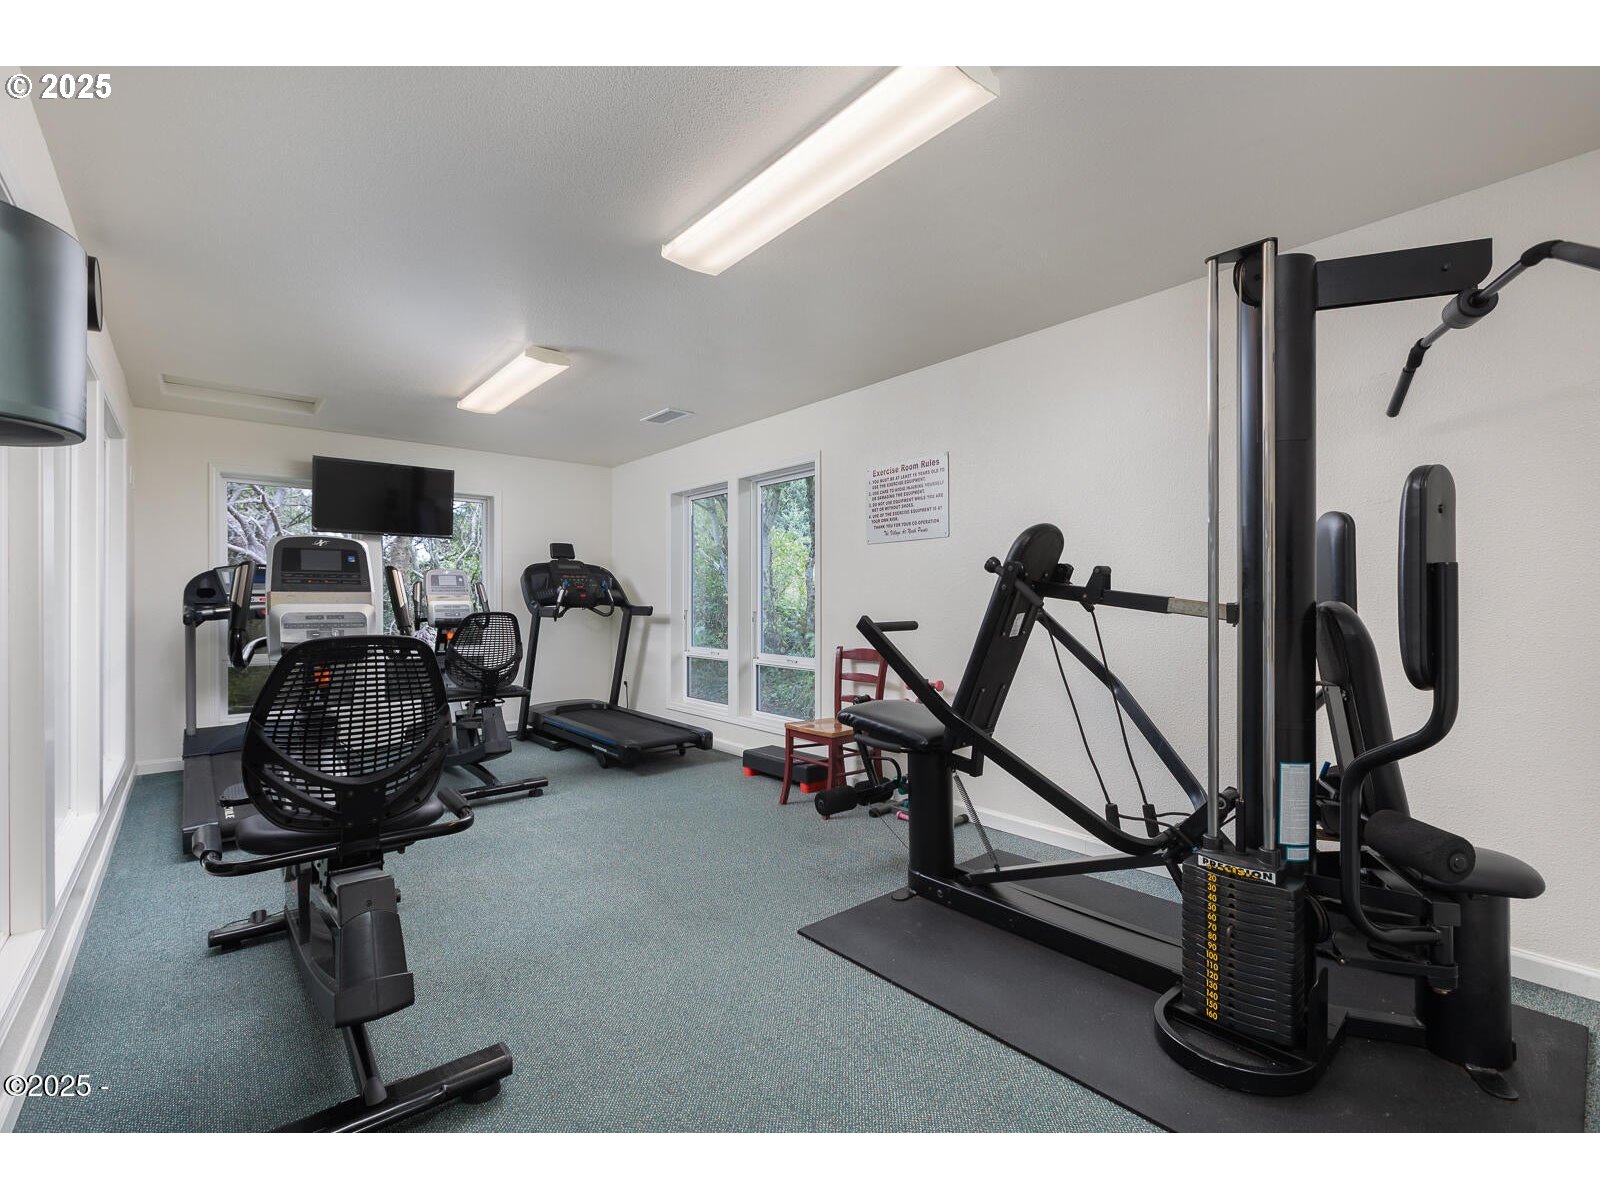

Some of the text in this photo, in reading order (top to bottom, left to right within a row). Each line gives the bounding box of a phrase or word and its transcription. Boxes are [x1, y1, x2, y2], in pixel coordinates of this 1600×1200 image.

[873, 467, 898, 477] Exercise
[921, 459, 939, 468] Rules
[1202, 858, 1272, 881] PRECISION
[1207, 874, 1216, 882] 20
[1207, 884, 1216, 892] 30
[1207, 894, 1216, 902] 40
[1207, 904, 1216, 912] 50
[1207, 913, 1216, 922] 60
[1207, 923, 1217, 931] 70
[1207, 932, 1217, 941] 80
[1207, 942, 1217, 951] 90
[1206, 951, 1218, 961] 100
[1206, 961, 1218, 971] 110
[1206, 970, 1218, 981] 120
[1206, 980, 1218, 990] 130
[1206, 990, 1218, 1000] 140
[1206, 999, 1218, 1010] 150
[1206, 1009, 1218, 1020] 160
